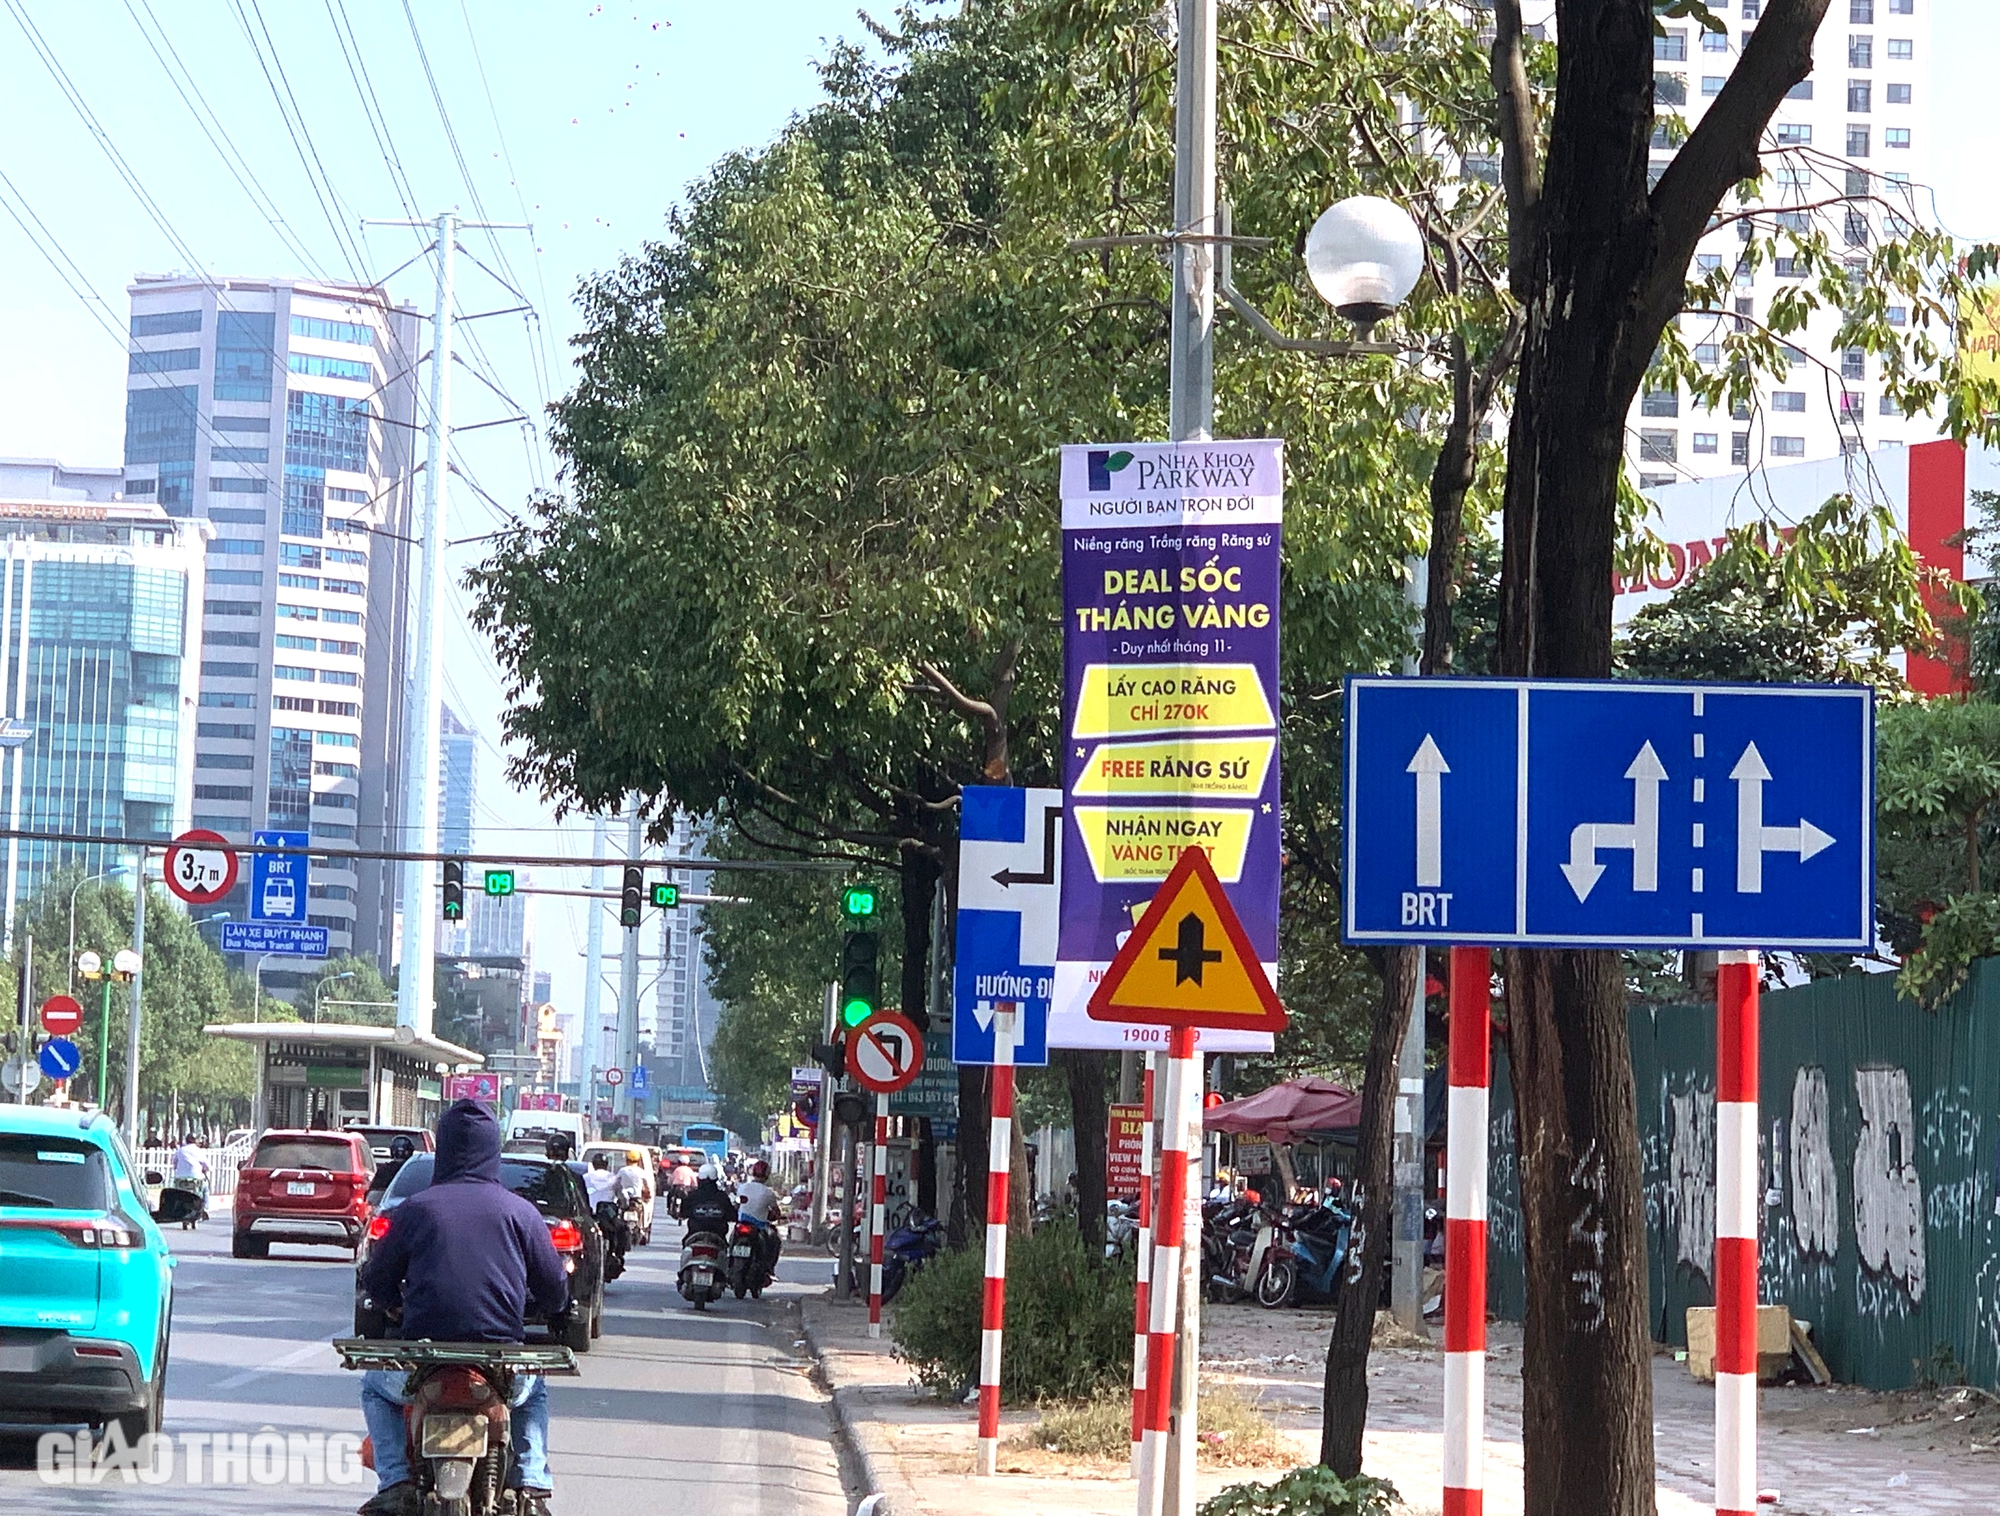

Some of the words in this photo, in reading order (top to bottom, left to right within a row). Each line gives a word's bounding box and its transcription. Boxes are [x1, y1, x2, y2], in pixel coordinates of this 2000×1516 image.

[1158, 452, 1198, 468] NHA
[1204, 452, 1255, 467] KHOA
[1138, 461, 1255, 490] PARKWAY
[1090, 498, 1142, 515] NGƯỜI
[1147, 499, 1177, 517] BẠN
[1181, 498, 1222, 515] TRỌN
[1226, 493, 1254, 511] ĐỜI
[1074, 537, 1111, 554] Niềng
[1115, 537, 1144, 551] răng
[1149, 533, 1182, 551] Trồng
[1186, 534, 1216, 550] răng
[1221, 533, 1253, 549] Răng
[1257, 532, 1271, 545] sứ
[1104, 569, 1172, 594] DEAL
[1180, 555, 1241, 593] SỐC
[1076, 599, 1175, 632] THÁNG
[1182, 597, 1270, 629] VÀNG
[1107, 674, 1137, 697] LẤY
[1141, 681, 1176, 696] CAO
[1180, 676, 1237, 696] RĂNG
[1130, 700, 1159, 721] CHỈ
[1163, 704, 1209, 720] 270K
[1101, 760, 1145, 778] FREE
[1150, 756, 1212, 778] RĂNG
[1219, 756, 1250, 779] SỨ
[1106, 815, 1161, 841] NHẬN
[1165, 820, 1222, 837] NGAY
[1111, 840, 1162, 861] VÀNG
[268, 861, 292, 874] BRT
[488, 873, 512, 894] 09
[655, 888, 676, 906] 09
[1401, 892, 1453, 927] BRT
[249, 929, 261, 938] XE
[291, 931, 323, 941] NHANH
[975, 970, 1032, 998] HƯỚNG
[1123, 1028, 1160, 1042] 1900
